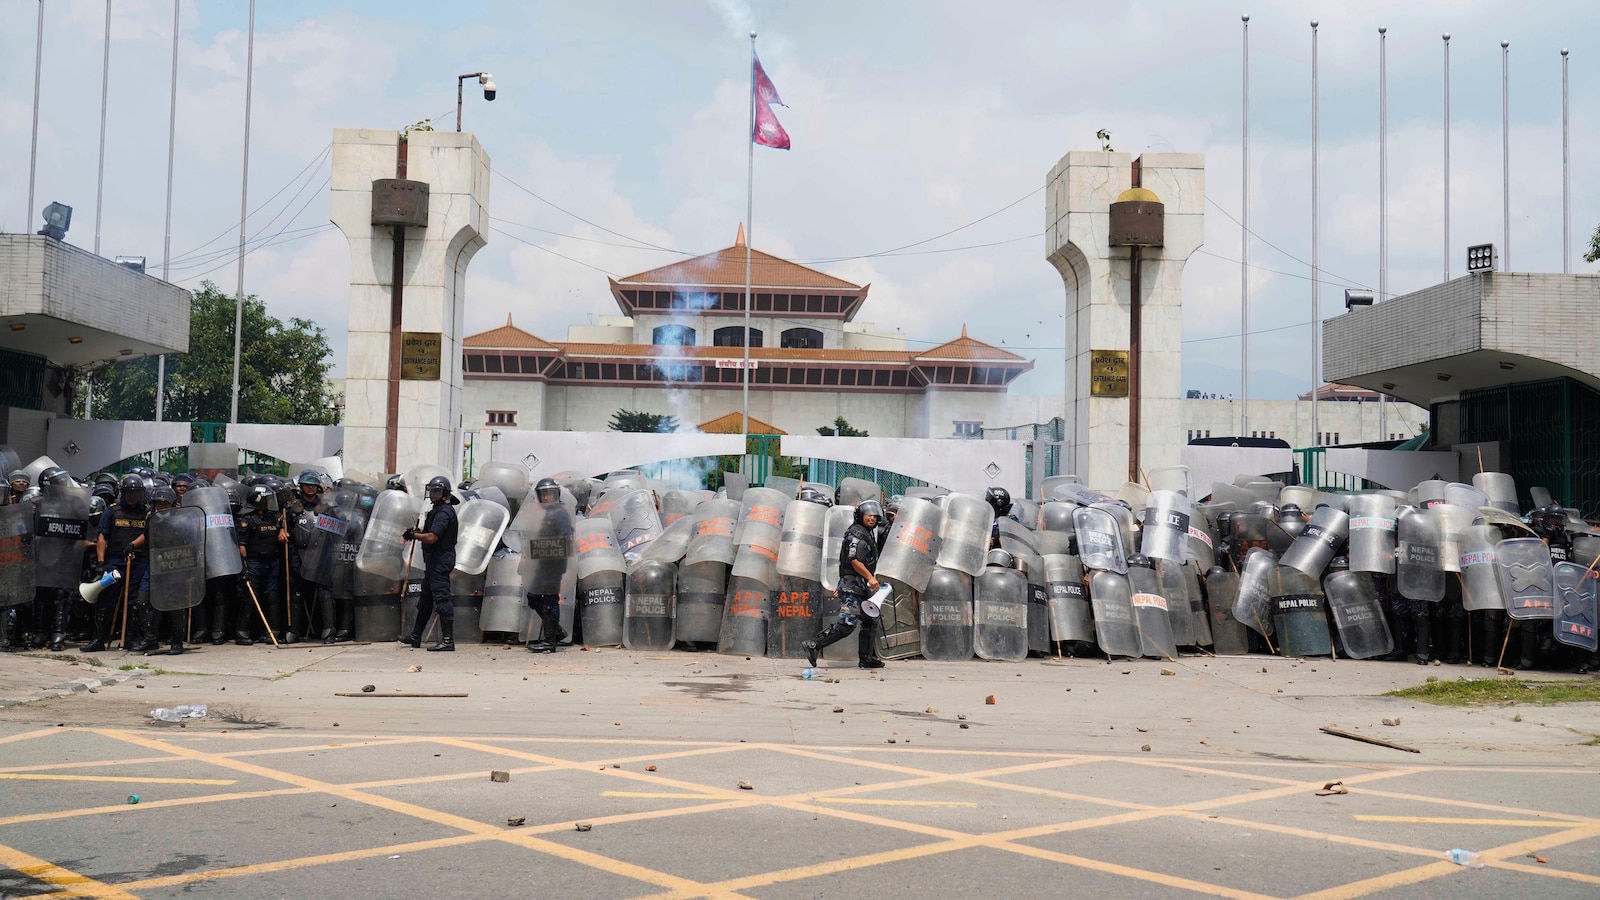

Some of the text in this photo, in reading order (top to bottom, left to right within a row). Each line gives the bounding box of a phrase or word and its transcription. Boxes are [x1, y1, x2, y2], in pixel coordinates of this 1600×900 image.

[210, 515, 233, 526] POLICE
[318, 516, 335, 530] NEPAL
[1351, 518, 1393, 529] NEPAL POLICE
[48, 522, 80, 535] NEPAL POLICE
[1088, 531, 1111, 541] NEPAL
[1090, 536, 1113, 546] POLICE
[534, 540, 562, 548] NEPAL
[898, 533, 930, 555] NEPAL
[164, 549, 191, 560] NEPAL
[532, 549, 565, 557] POLICE
[1411, 546, 1435, 555] NEPAL
[1410, 554, 1436, 563] POLICE
[1461, 554, 1480, 565] NEPAL
[161, 560, 195, 569] POLICE
[408, 583, 422, 592] NEPAL
[589, 588, 615, 597] NEPAL
[1054, 586, 1081, 596] NEPAL POLICE
[589, 595, 616, 605] POLICE
[638, 597, 665, 605] NEPAL
[1134, 593, 1153, 606] NEPAL
[1279, 599, 1318, 609] NEPAL POLICE
[636, 605, 666, 614] POLICE
[730, 603, 761, 619] NEPAL
[778, 605, 812, 618] NEPAL
[933, 605, 960, 613] NEPAL
[988, 605, 1015, 613] NEPAL
[1345, 605, 1370, 615] NEPAL
[932, 613, 962, 621] POLICE
[988, 613, 1016, 622] POLICE
[1347, 612, 1374, 621] POLICE
